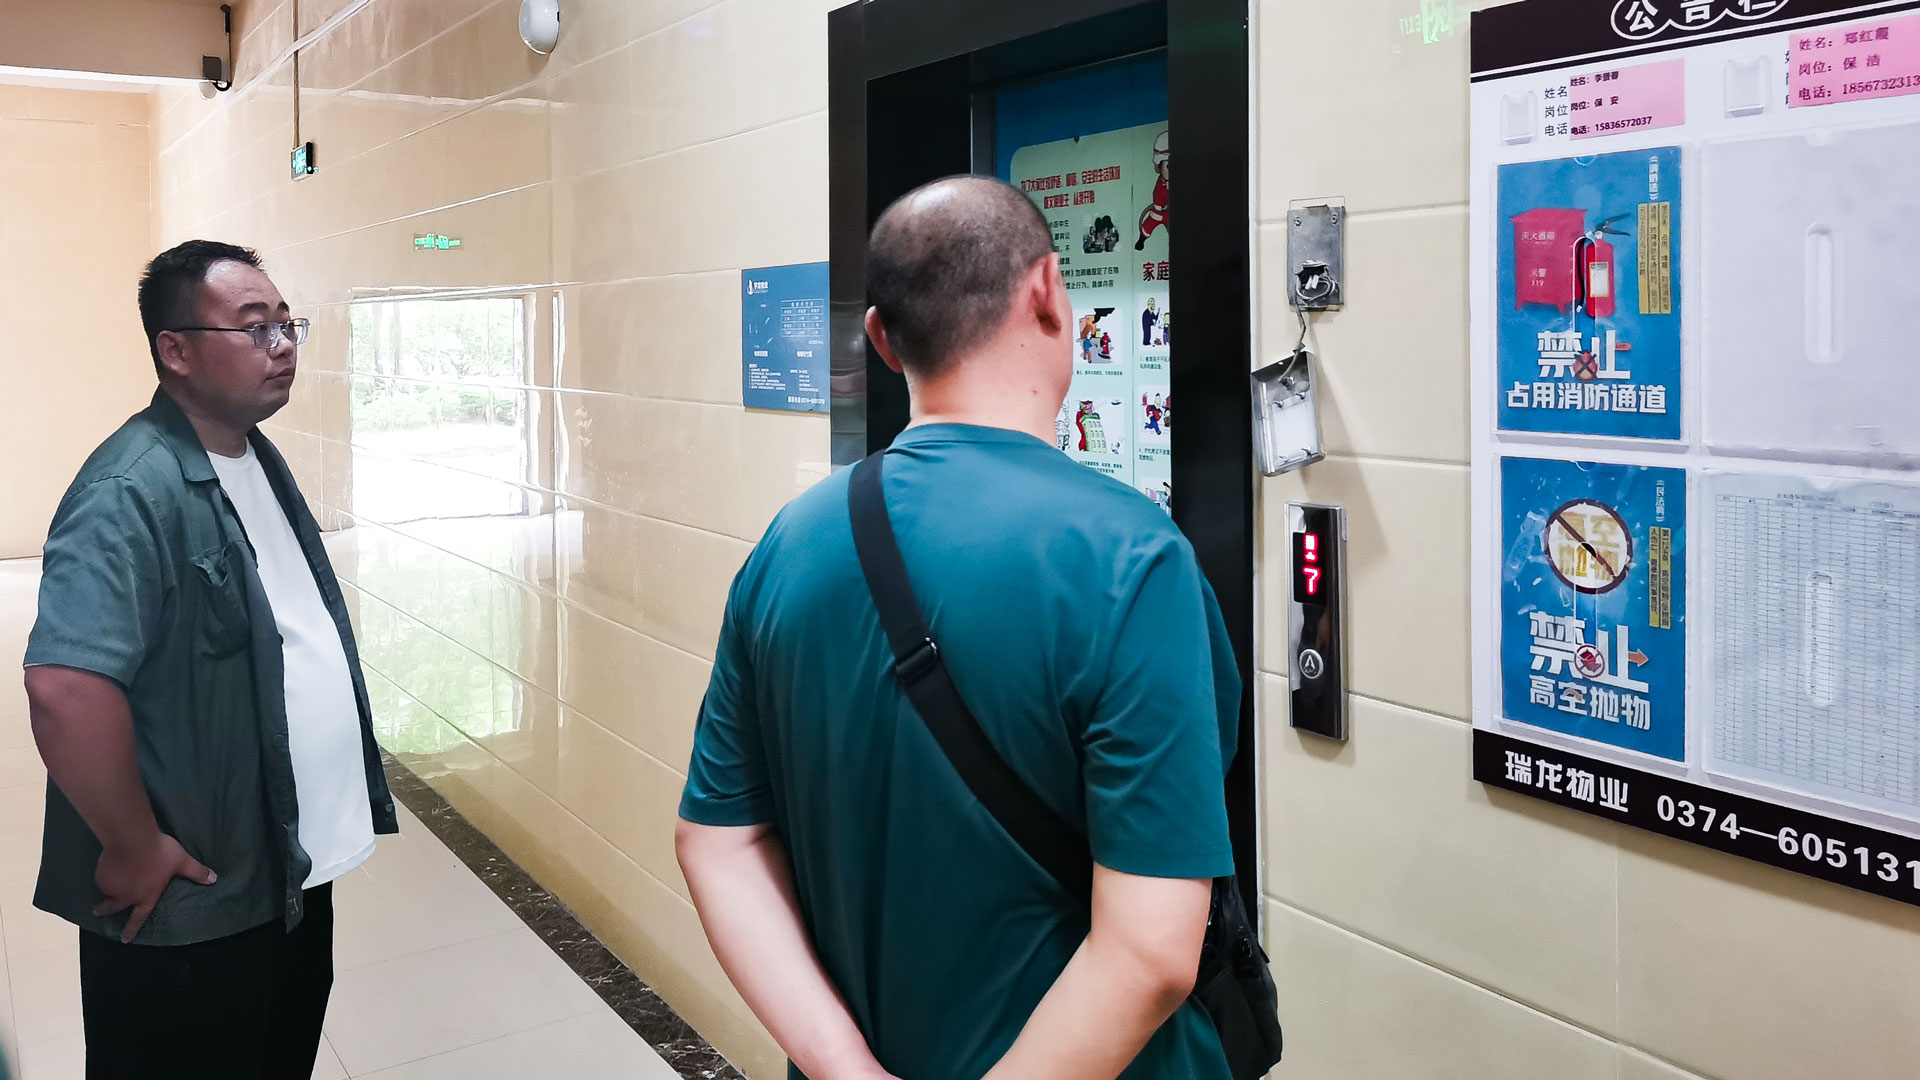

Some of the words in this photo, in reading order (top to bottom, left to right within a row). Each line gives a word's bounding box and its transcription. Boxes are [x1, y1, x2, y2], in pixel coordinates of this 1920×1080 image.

[1544, 86, 1568, 100] 姓名
[1544, 104, 1568, 119] 岗位
[1544, 122, 1568, 137] 电话
[1537, 329, 1631, 380] 禁止
[1506, 380, 1667, 414] 占用消防通道
[1302, 567, 1320, 595] 7
[1529, 611, 1649, 694] 禁止
[1529, 674, 1651, 731] 高空抛物
[1504, 750, 1628, 814] 瑞龙物业
